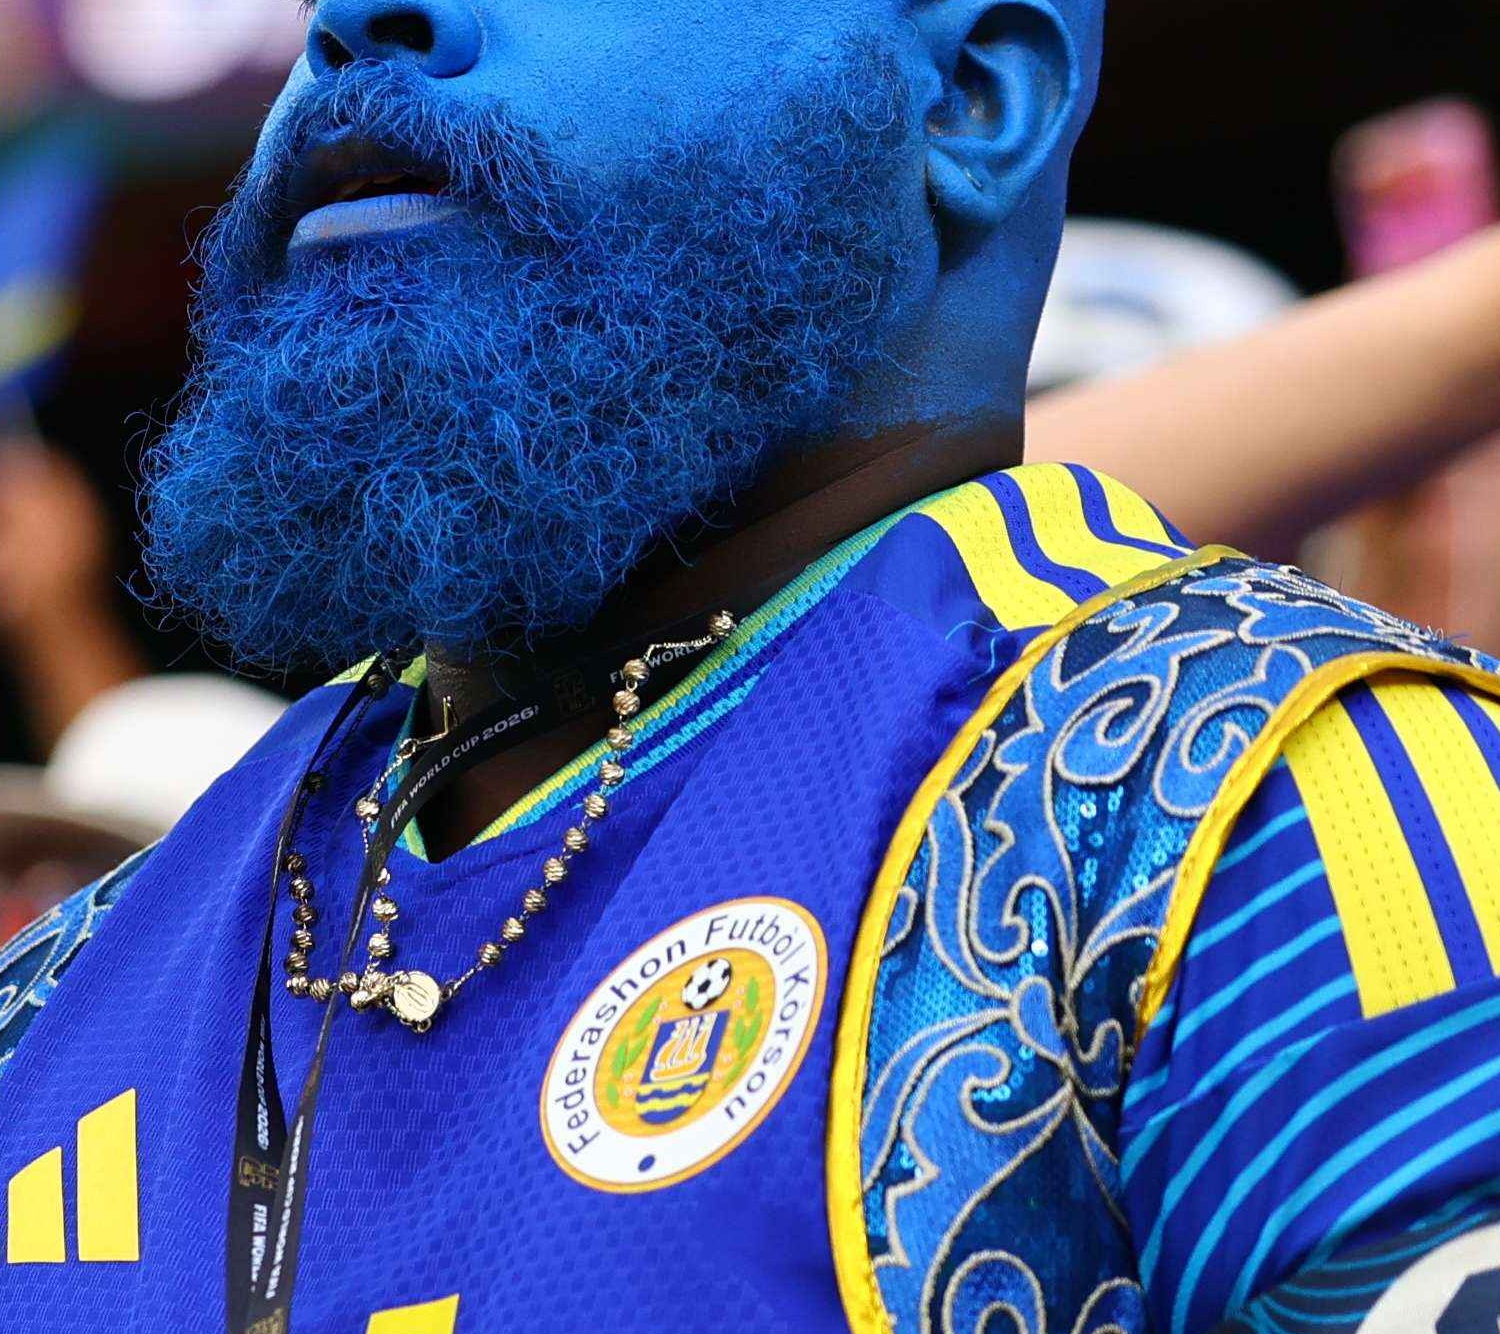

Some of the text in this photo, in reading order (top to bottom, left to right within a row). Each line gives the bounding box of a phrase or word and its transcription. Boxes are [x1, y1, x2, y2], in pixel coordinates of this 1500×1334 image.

[409, 755, 451, 799] WORLD
[452, 735, 480, 759] CUP
[482, 706, 535, 742] 2026
[555, 937, 687, 1155] Federashon
[252, 1203, 268, 1233] FIFA
